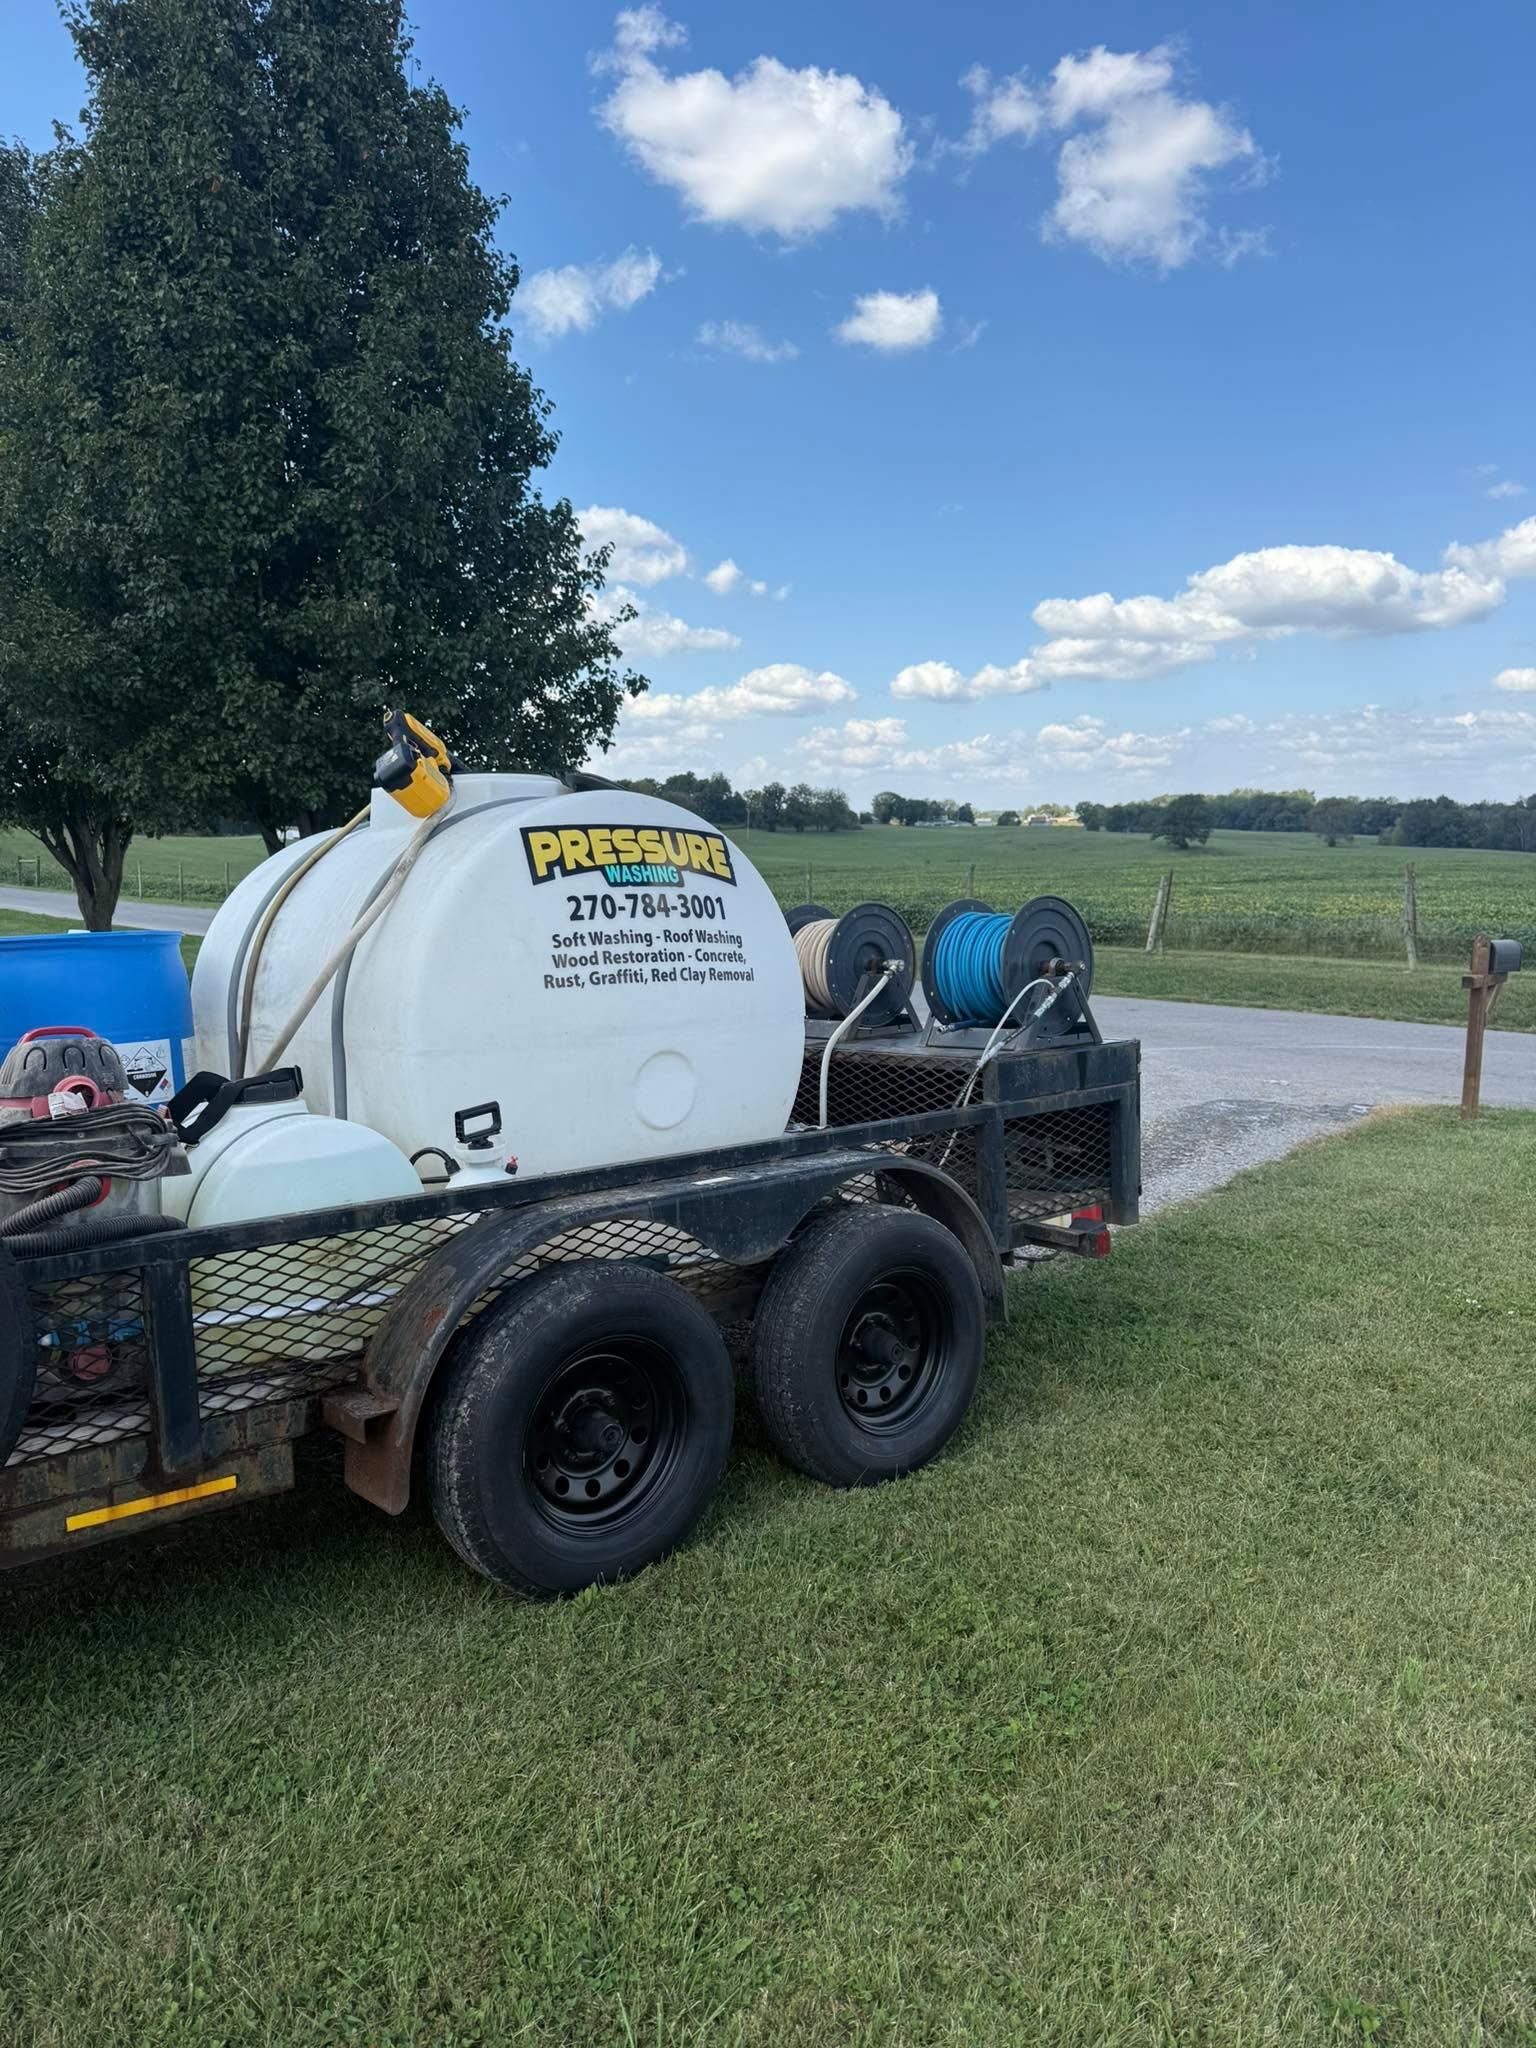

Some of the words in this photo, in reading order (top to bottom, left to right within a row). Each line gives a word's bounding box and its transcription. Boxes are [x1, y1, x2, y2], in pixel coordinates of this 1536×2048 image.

[528, 829, 731, 878] PRESSURE
[604, 864, 679, 883] WASHING
[566, 893, 726, 921] 270-784-3001
[551, 931, 587, 949] Soft
[588, 929, 653, 947] Washing
[663, 929, 694, 943] Roof
[695, 930, 743, 948] Washing
[551, 951, 600, 969] Wood
[602, 948, 685, 965] Restoration
[694, 948, 747, 965] Concrete,
[543, 973, 585, 989] Rust,
[588, 968, 648, 985] Graffiti,
[651, 967, 677, 982] Red
[679, 966, 707, 985] Clay
[708, 967, 755, 982] Removal
